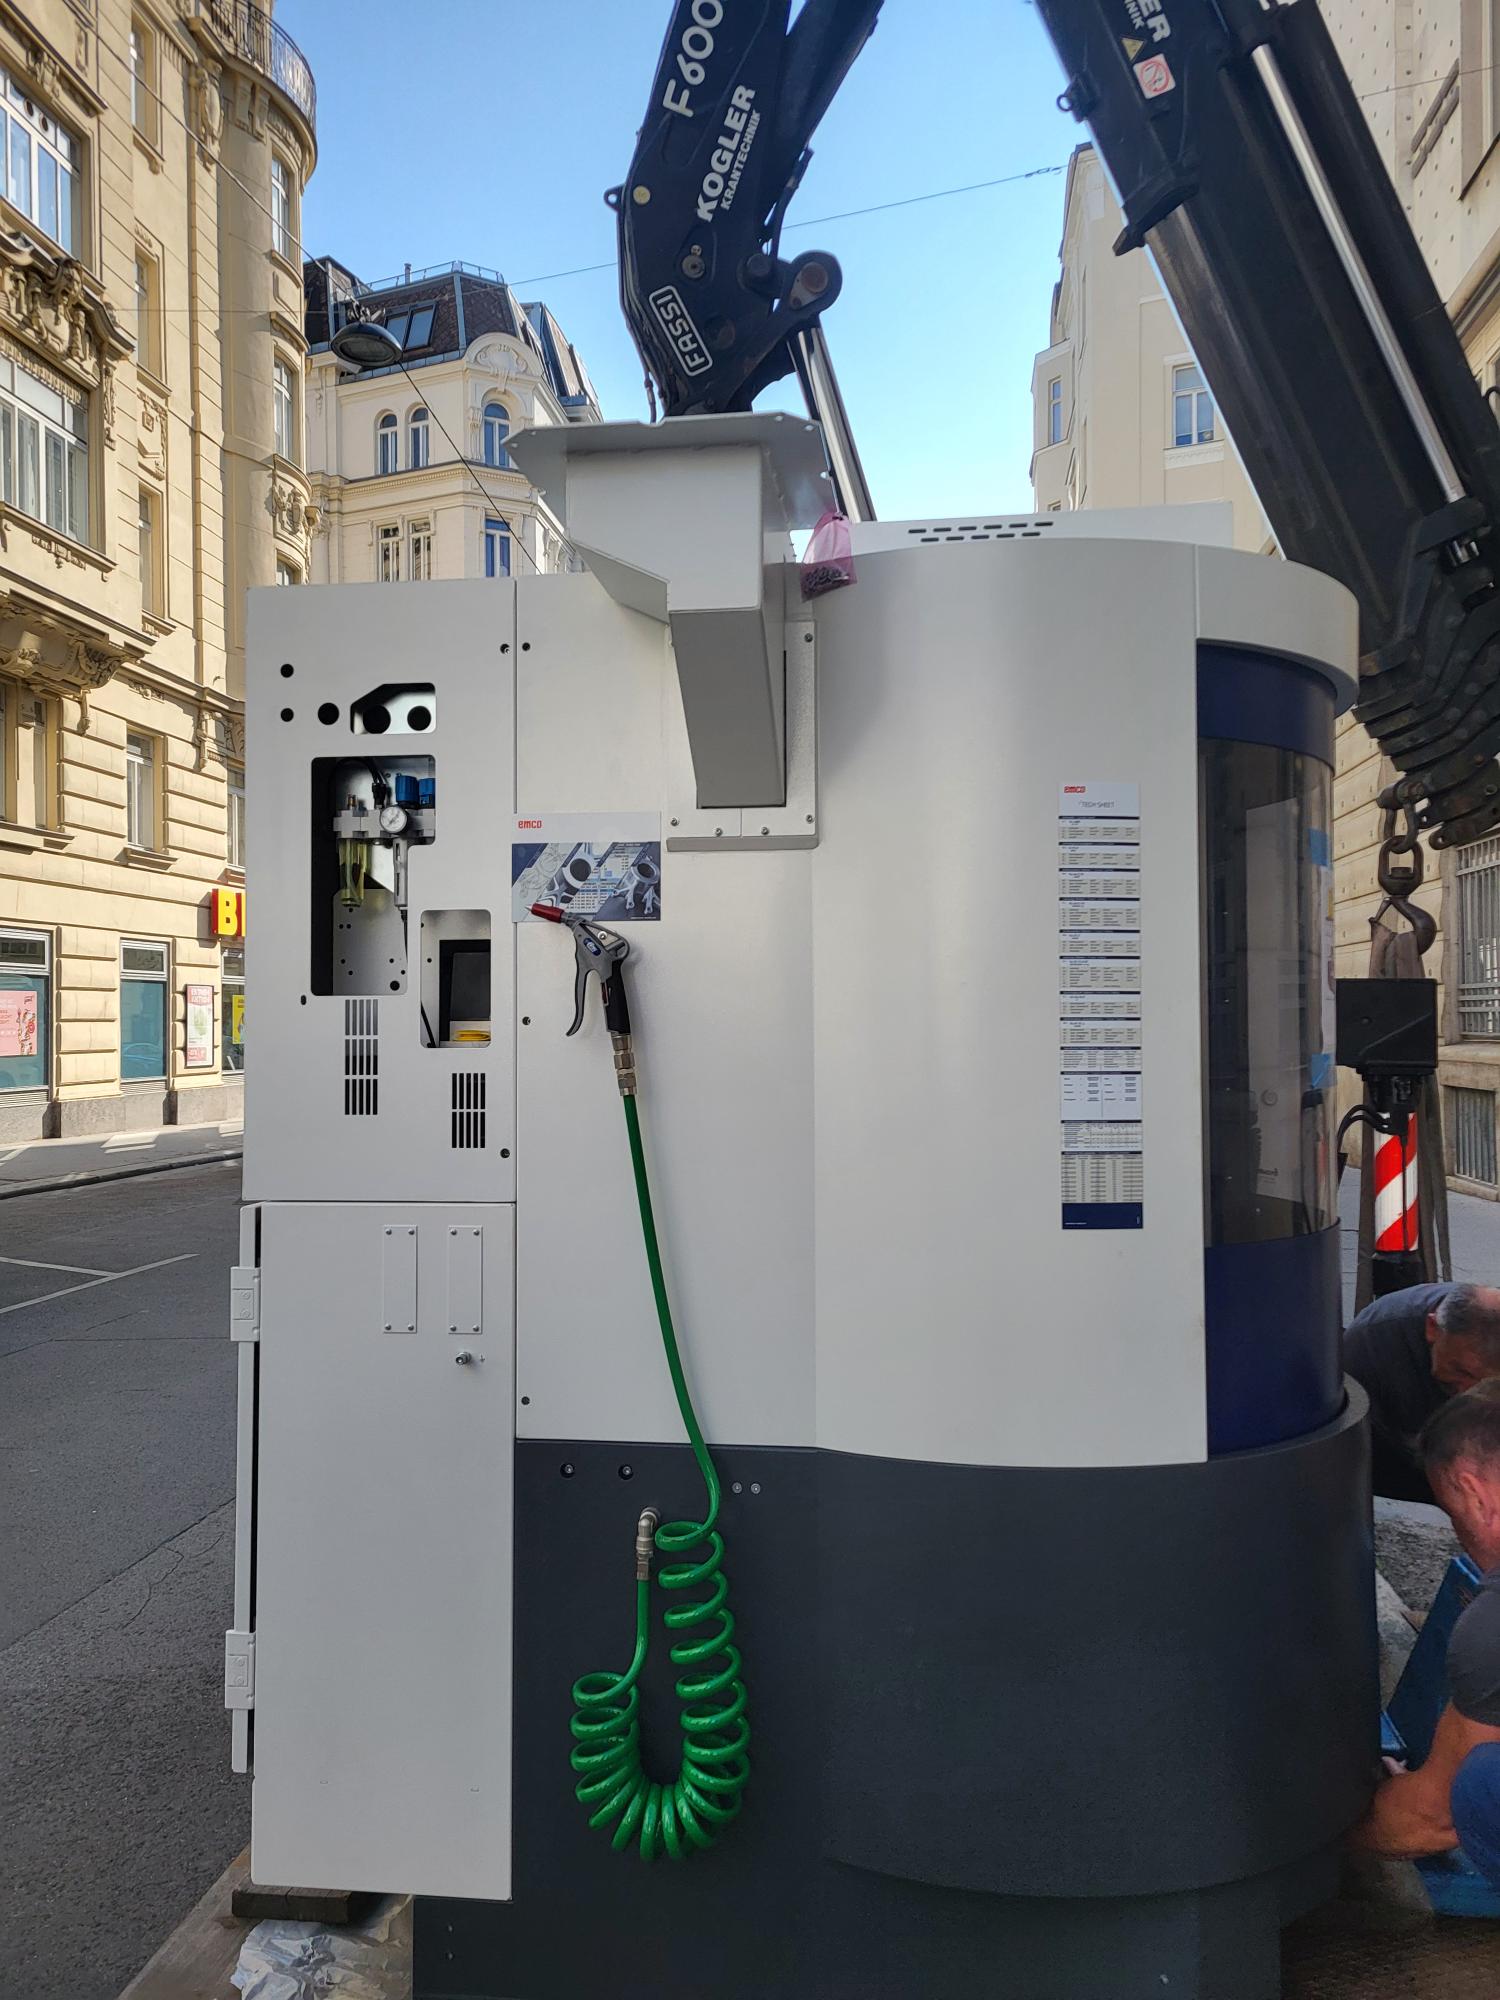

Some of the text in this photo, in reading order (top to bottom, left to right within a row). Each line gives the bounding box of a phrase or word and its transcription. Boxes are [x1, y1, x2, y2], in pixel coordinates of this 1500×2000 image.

[662, 0, 724, 118] F600
[696, 85, 756, 223] KOGLER
[720, 109, 761, 210] KRANTECHNIK
[656, 294, 705, 368] FASSI
[517, 819, 542, 829] emco
